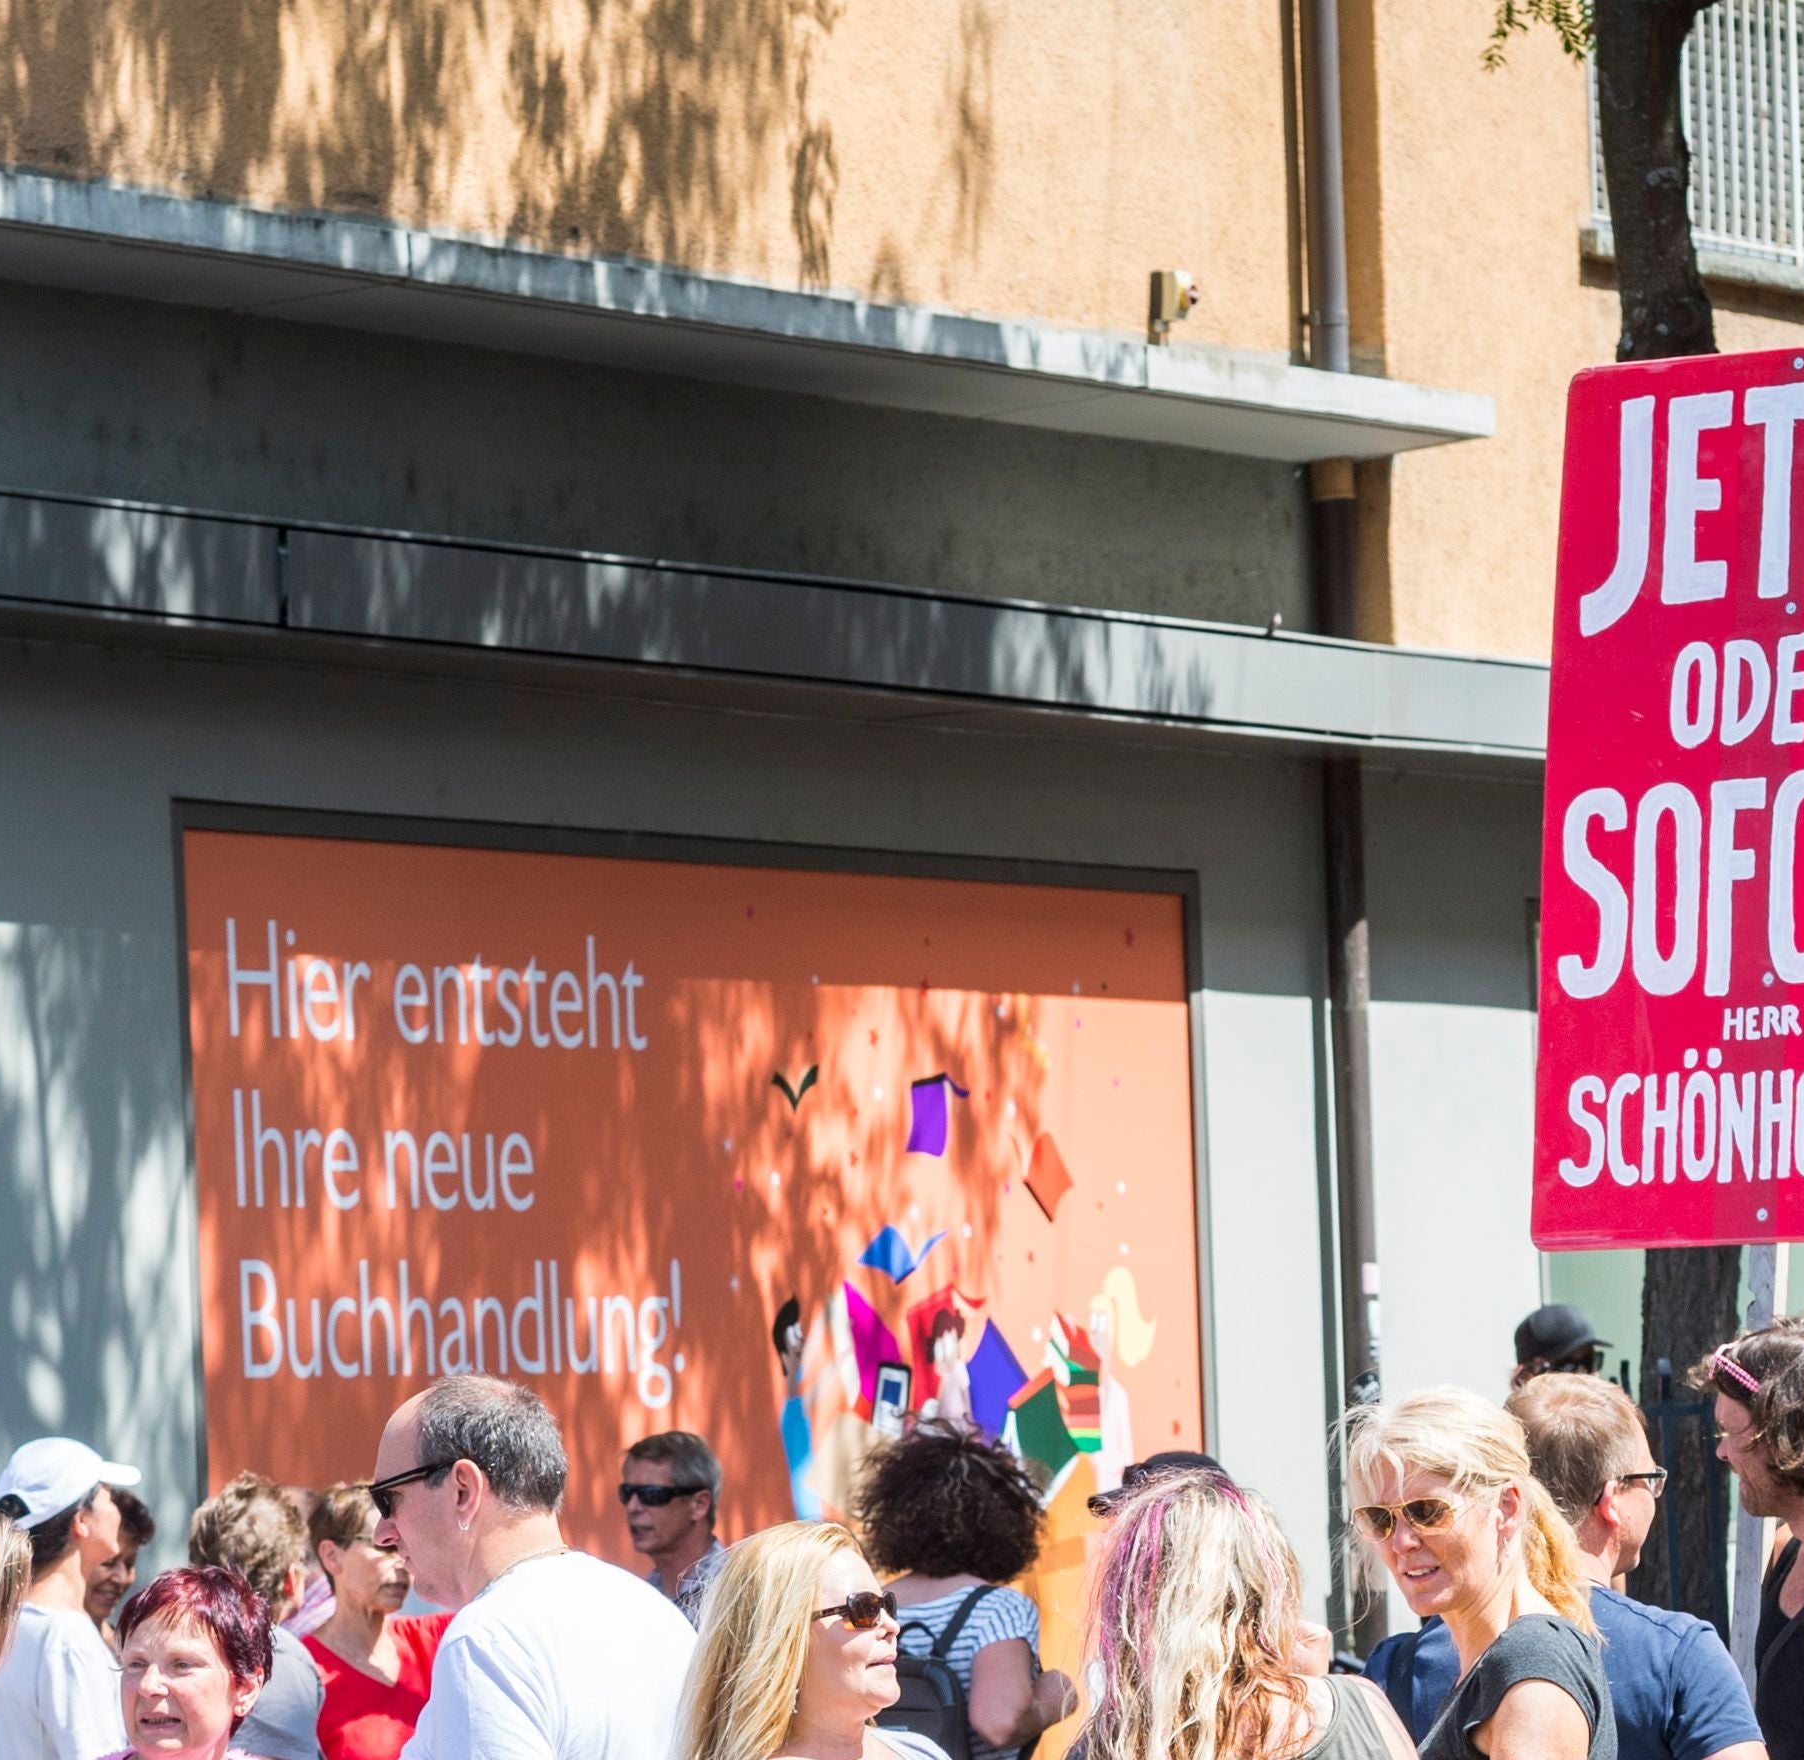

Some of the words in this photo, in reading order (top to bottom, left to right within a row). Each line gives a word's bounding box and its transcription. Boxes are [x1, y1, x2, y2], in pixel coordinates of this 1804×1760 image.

[226, 917, 371, 1042] Hier
[393, 935, 648, 1051] entsteht
[1721, 1004, 1802, 1042] HERR
[233, 1088, 360, 1210] Ihre
[384, 1129, 535, 1212] neue
[240, 1258, 686, 1409] Buchhandlung!
